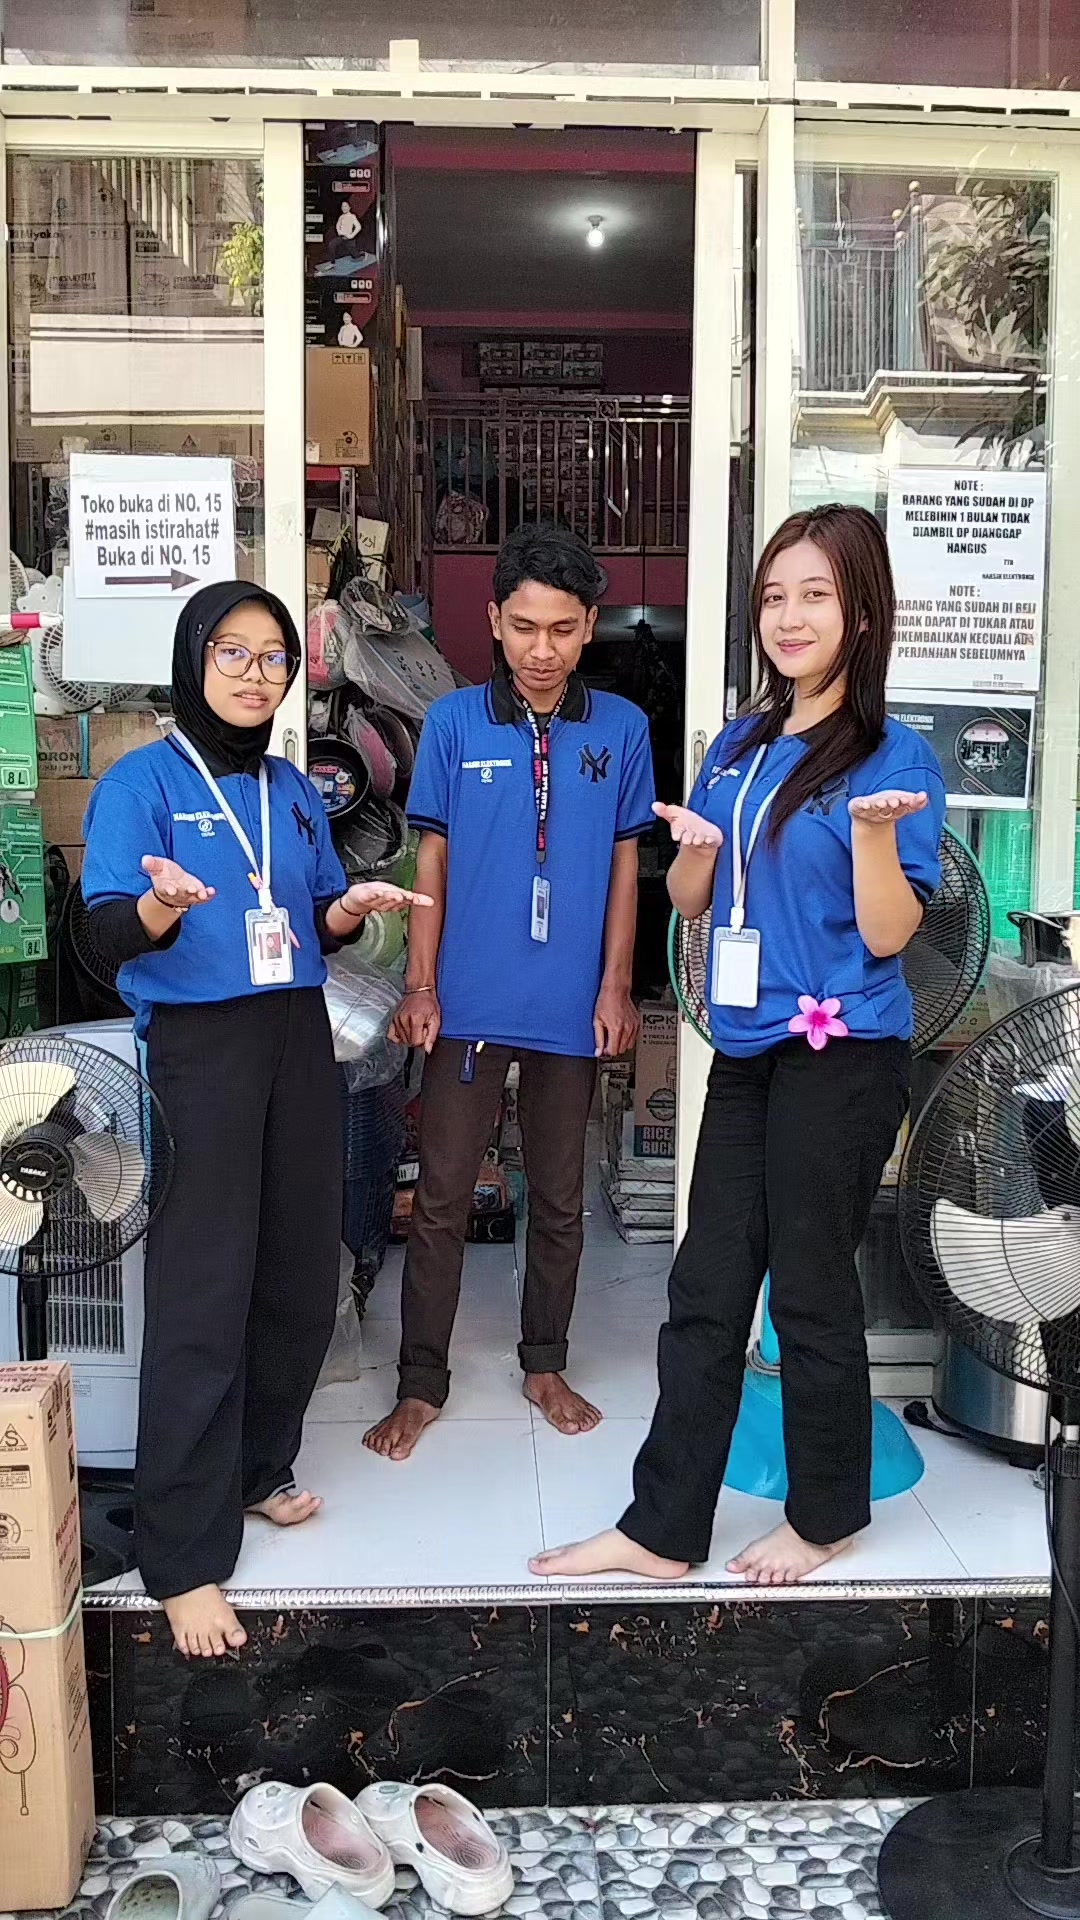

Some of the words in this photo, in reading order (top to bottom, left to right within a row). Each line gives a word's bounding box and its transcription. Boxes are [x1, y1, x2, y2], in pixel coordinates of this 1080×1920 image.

[954, 479, 979, 491] NOTE
[80, 494, 115, 513] Toko
[119, 494, 154, 513] buka
[157, 493, 170, 513] di
[175, 493, 201, 513] NO.
[205, 492, 222, 513] 15
[902, 494, 942, 506] BARANG
[945, 495, 970, 507] YANG
[972, 496, 1006, 507] SUDAH
[1008, 497, 1018, 508] DI
[1020, 497, 1034, 508] DP
[905, 511, 957, 522] MELEBIHIN
[960, 512, 965, 522] 1
[966, 512, 999, 523] BULAN
[1001, 512, 1031, 524] TIDAK
[85, 519, 141, 541] #masih
[145, 518, 220, 539] istirahat#
[912, 526, 954, 538] DIAMBIL
[956, 527, 970, 538] DP
[972, 528, 1022, 539] DIANGGAP
[97, 545, 136, 566] Buka
[141, 544, 154, 566] di
[159, 544, 187, 566] NO.
[192, 544, 211, 565] 15
[947, 543, 987, 554] HANGUS
[949, 585, 976, 597] NOTE
[935, 600, 962, 613] YANG
[964, 601, 1000, 613] SUDAH
[1002, 602, 1013, 614] DI
[1015, 603, 1036, 614] BELI
[924, 616, 958, 628] DAPAT
[959, 617, 971, 629] DI
[973, 617, 1007, 629] TUKAR
[1009, 618, 1035, 630] ATAU
[969, 632, 1012, 645] KECUALI
[897, 646, 958, 659] PERJANJIAN
[959, 648, 1026, 661] SEBELUMNYA
[8, 771, 15, 785] 8
[18, 772, 25, 785] L
[642, 1126, 671, 1141] RICE
